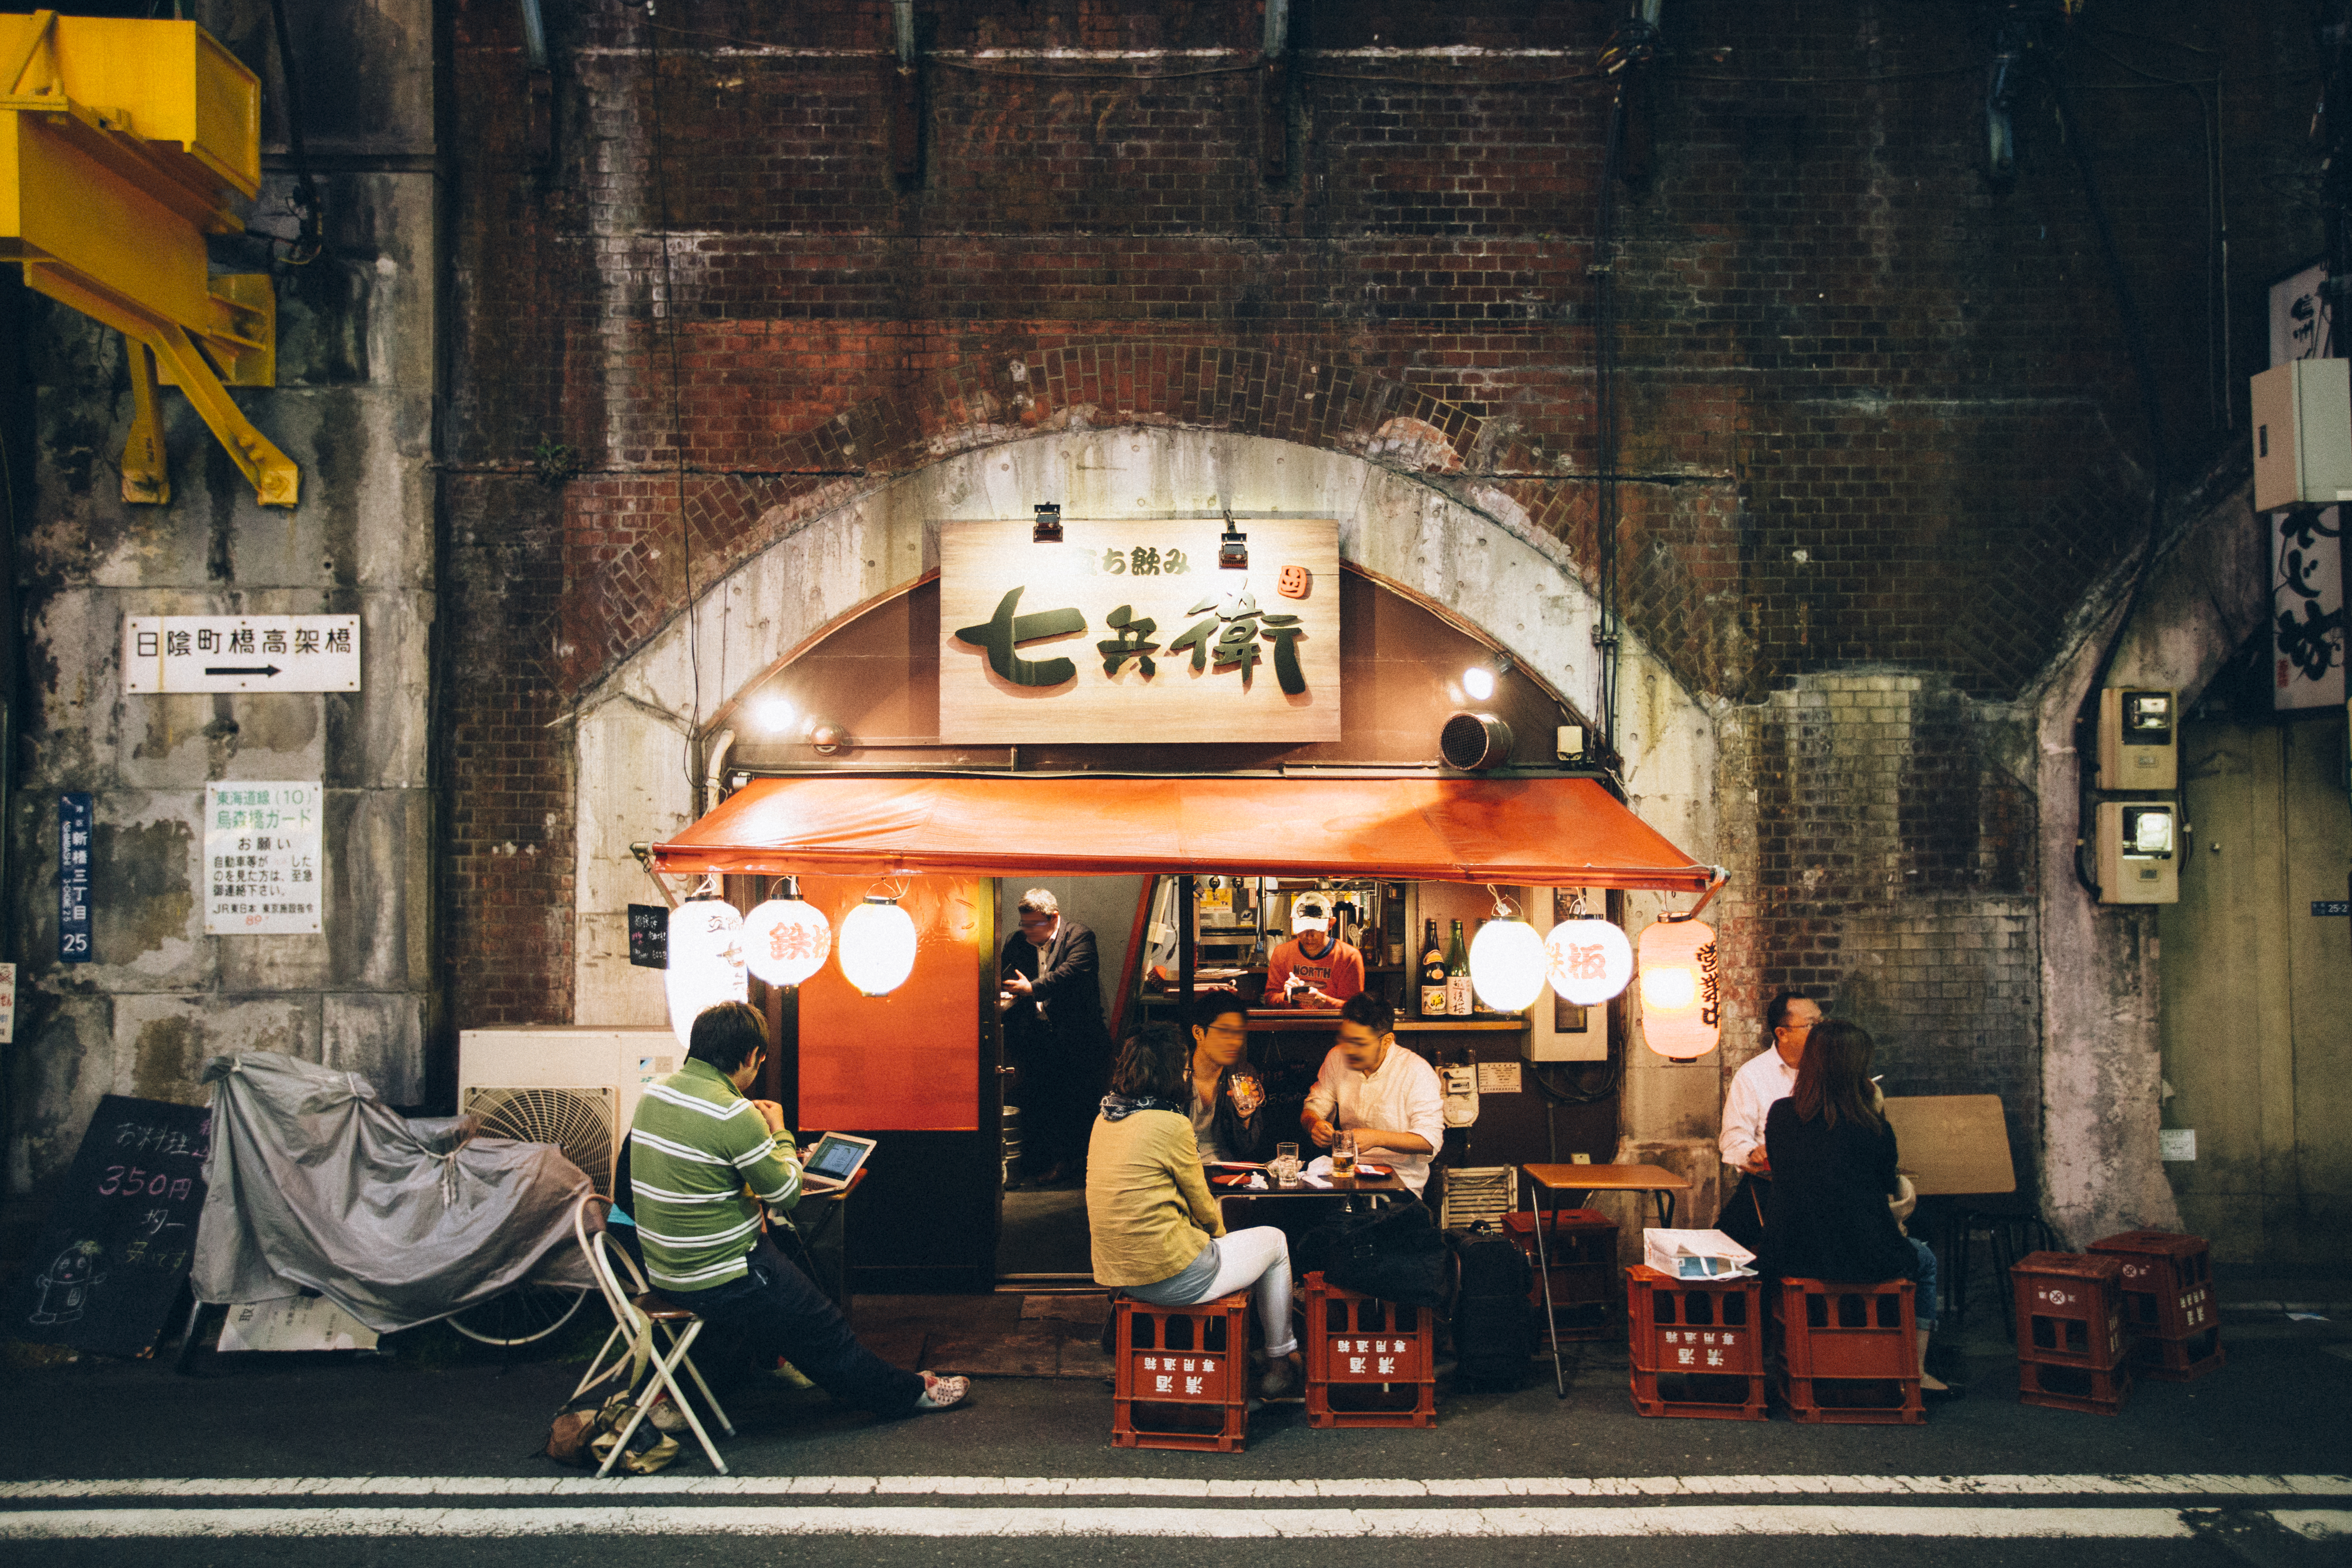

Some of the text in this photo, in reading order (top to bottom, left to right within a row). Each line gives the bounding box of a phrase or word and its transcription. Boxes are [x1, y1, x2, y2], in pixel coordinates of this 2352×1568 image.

[138, 628, 351, 656] 日陰町橋高架橋
[955, 578, 1306, 694] 七兵衛
[238, 837, 291, 851] お願い
[64, 933, 87, 952] 25
[769, 922, 831, 961] 鉄板
[1293, 964, 1331, 979] NORTH
[99, 1165, 192, 1200] 350円
[1144, 1357, 1216, 1373] 専用通箱
[1350, 1357, 1395, 1375] 清酒
[1678, 1348, 1724, 1367] 清酒
[1156, 1375, 1203, 1395] 清酒
